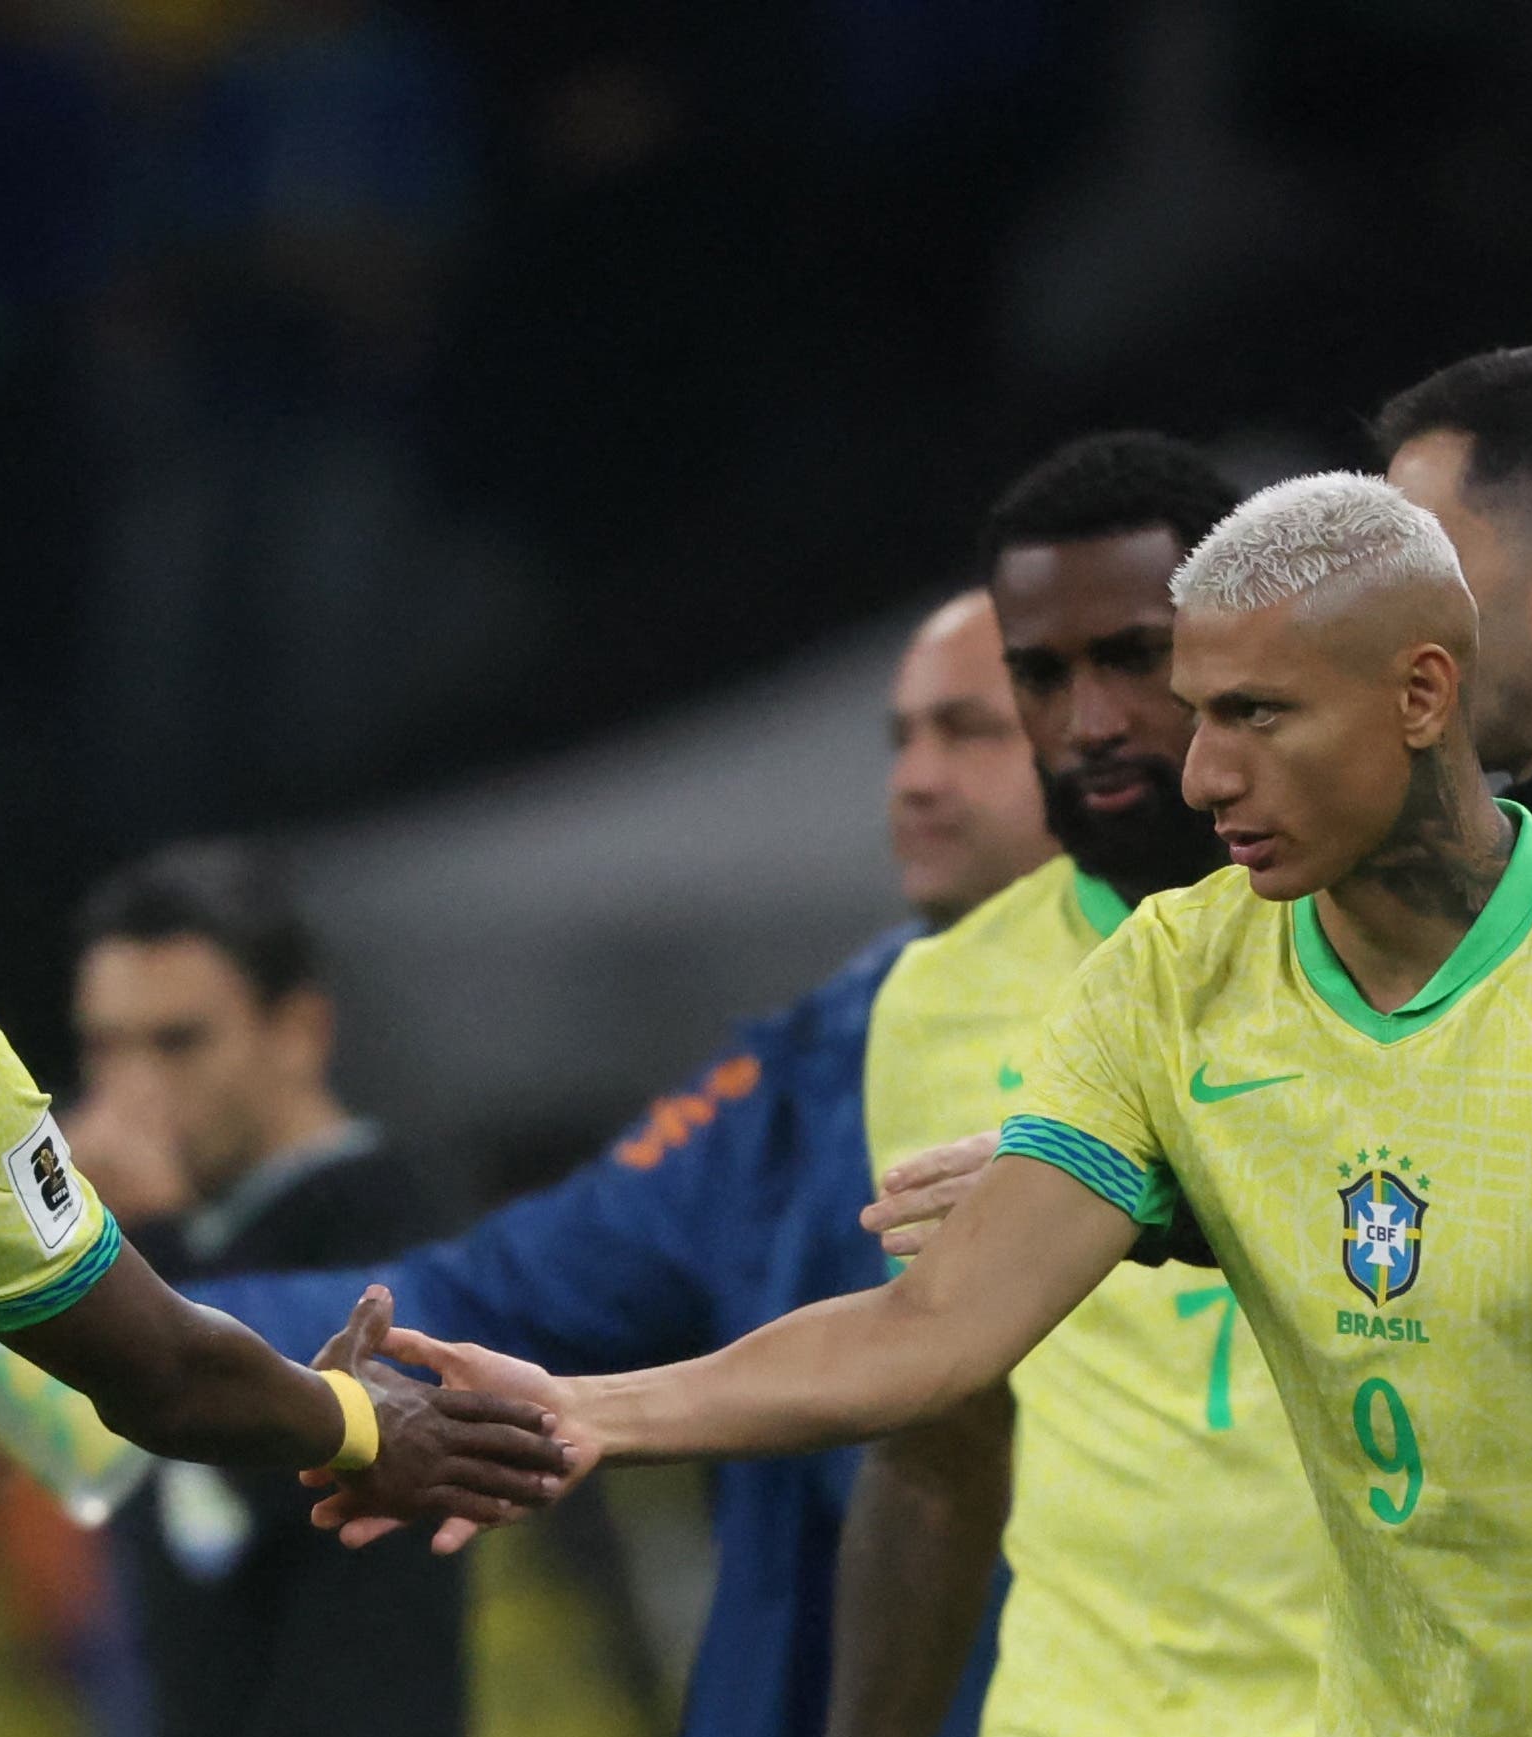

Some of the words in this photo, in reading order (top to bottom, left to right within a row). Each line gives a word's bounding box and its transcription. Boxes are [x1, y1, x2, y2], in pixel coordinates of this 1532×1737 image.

[1366, 1224, 1398, 1243] CBF
[1173, 1283, 1237, 1432] 7
[1336, 1310, 1431, 1345] BRASIL
[1351, 1376, 1425, 1526] 9
